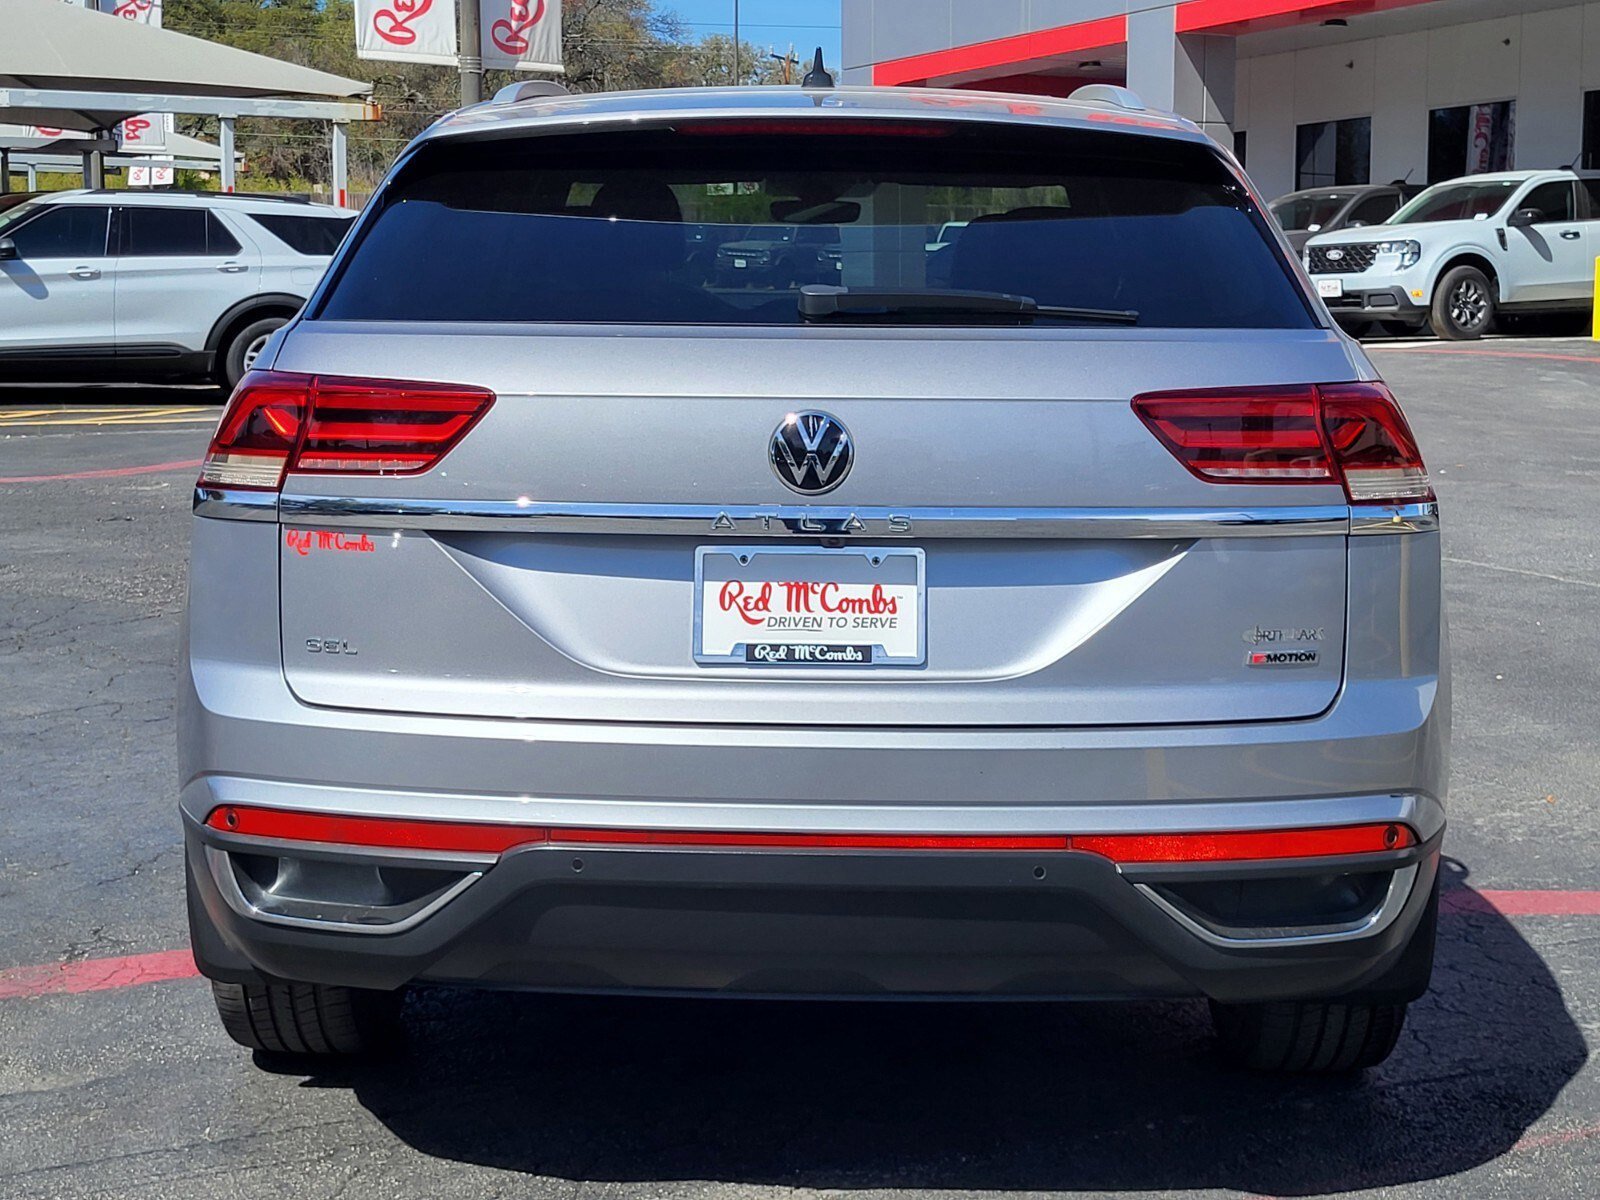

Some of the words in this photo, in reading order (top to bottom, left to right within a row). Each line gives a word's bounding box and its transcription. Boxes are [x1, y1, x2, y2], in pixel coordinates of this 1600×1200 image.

[373, 0, 433, 45] Re
[711, 511, 912, 532] ATLAS
[719, 580, 772, 625] Red
[767, 617, 823, 629] DRIVEN
[828, 617, 848, 628] TO
[852, 617, 898, 629] SERVE
[306, 638, 358, 655] SEL
[754, 644, 788, 661] Red
